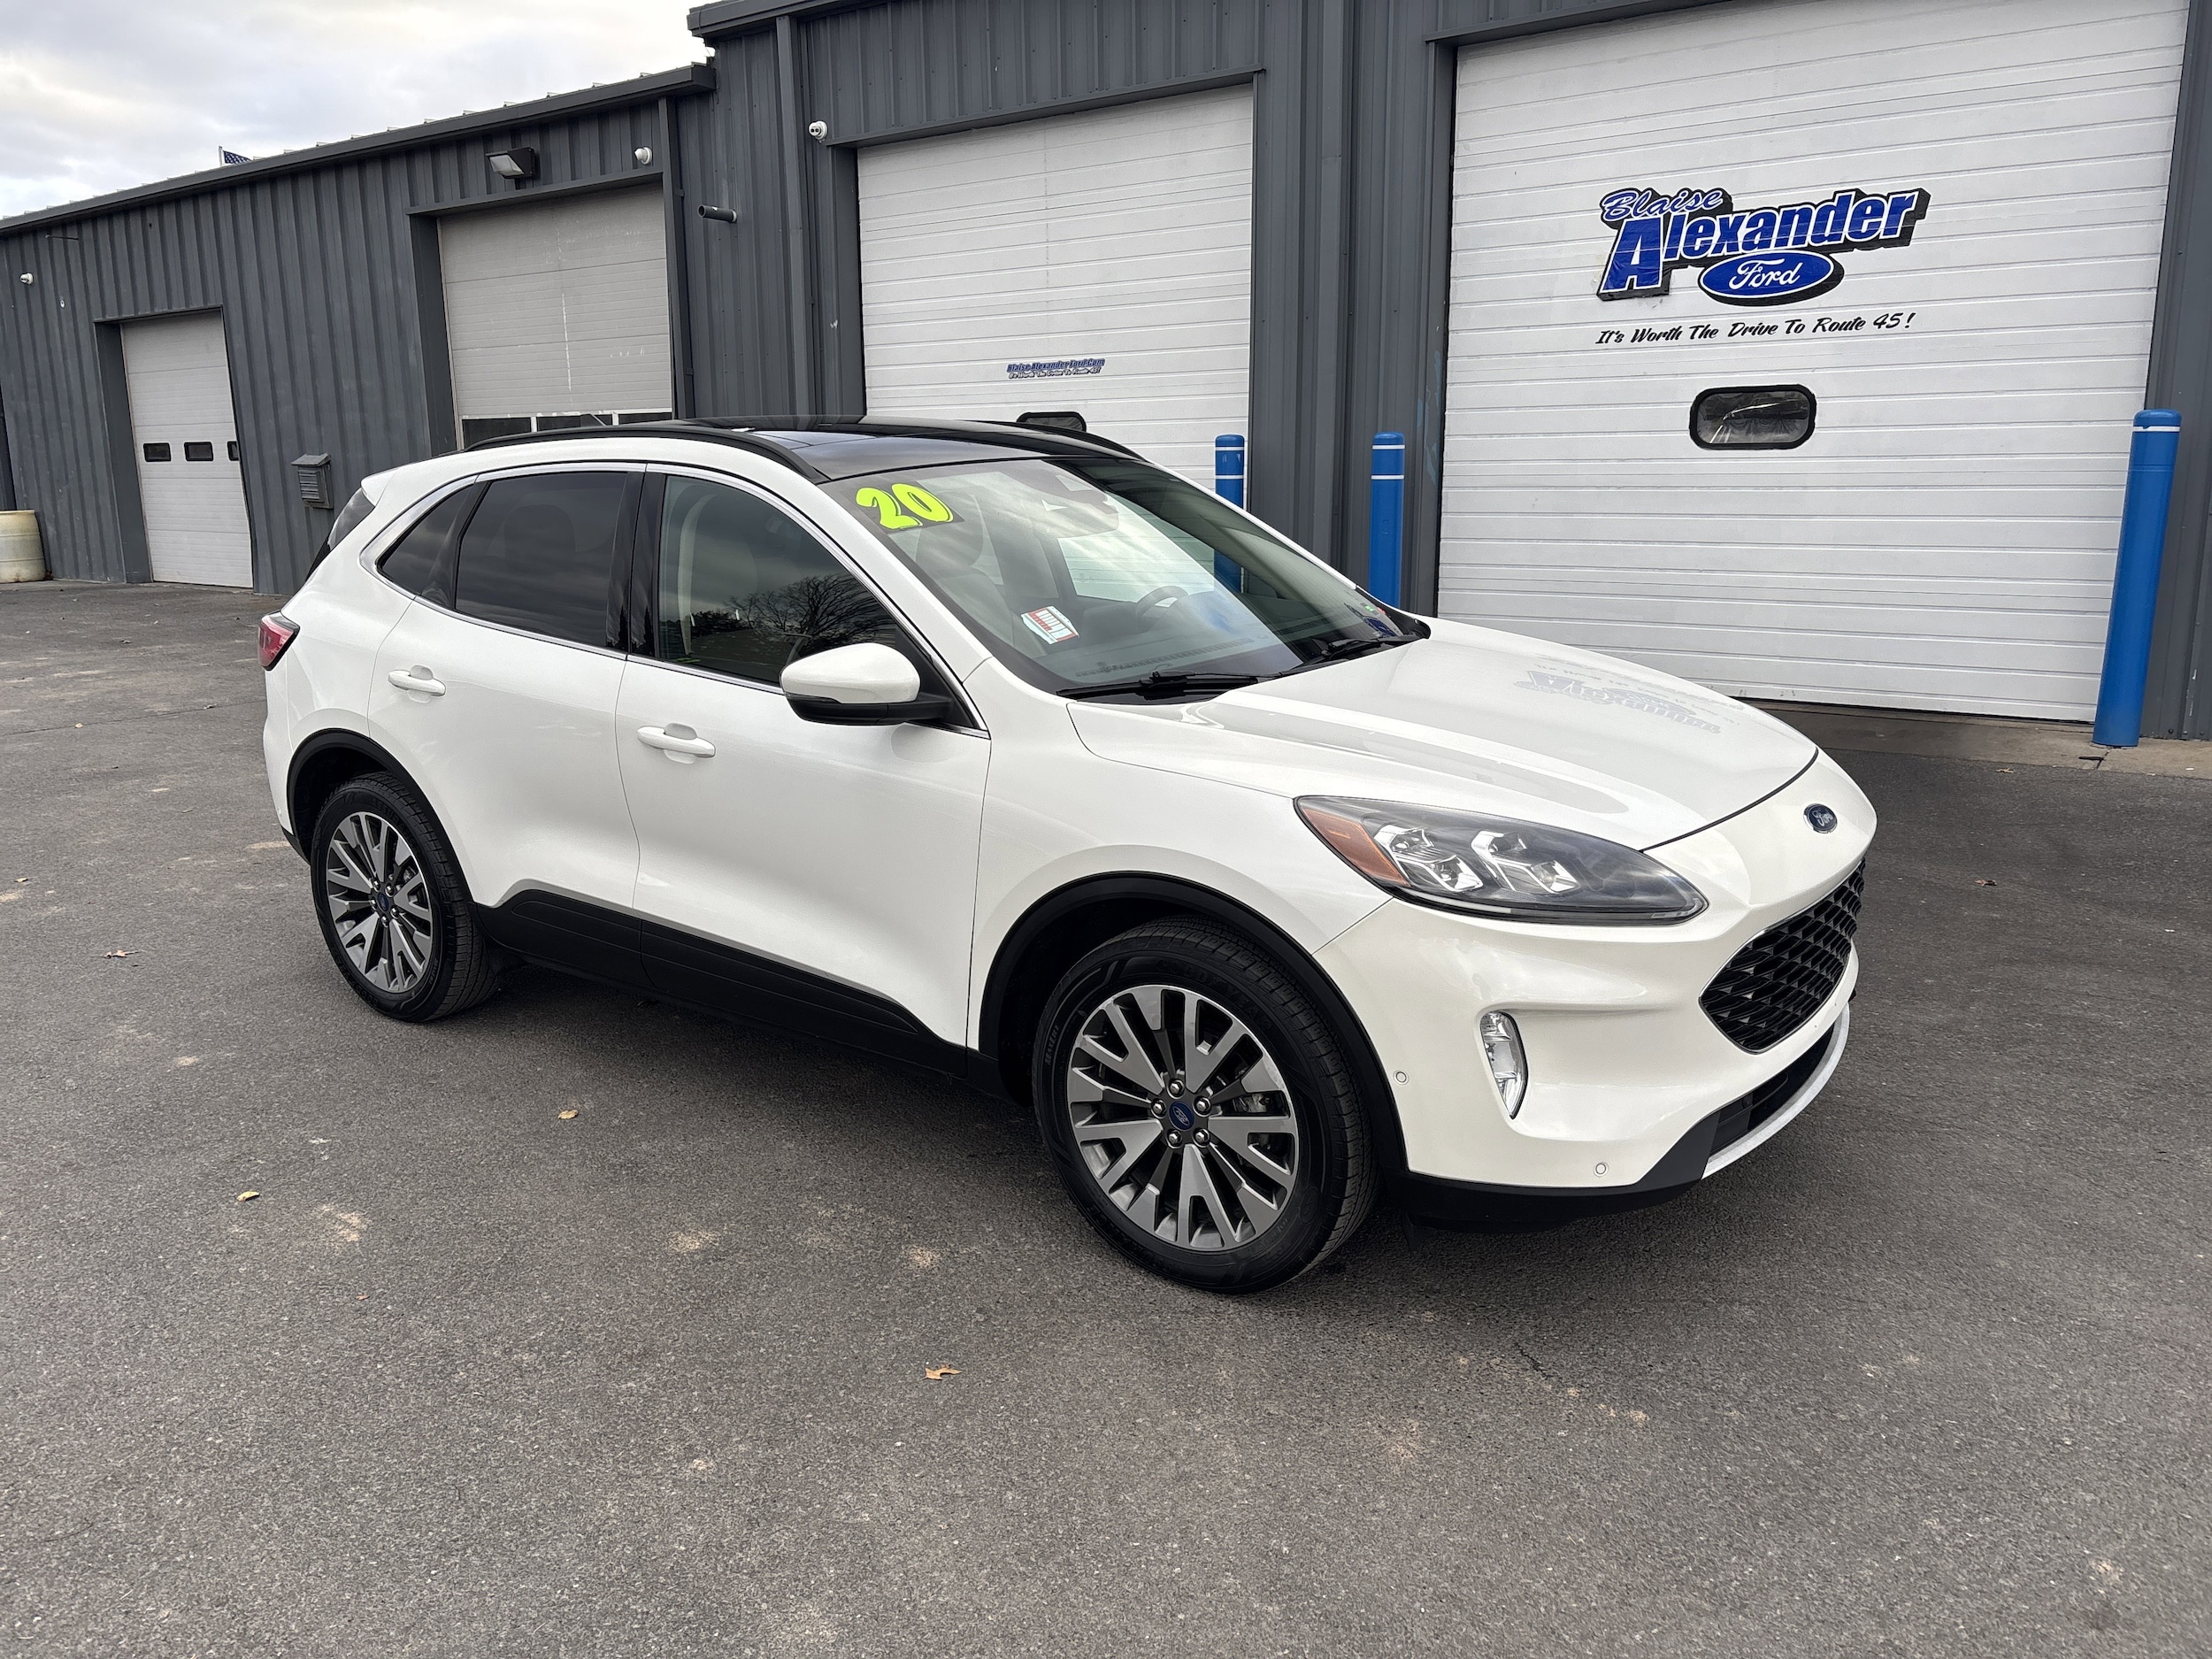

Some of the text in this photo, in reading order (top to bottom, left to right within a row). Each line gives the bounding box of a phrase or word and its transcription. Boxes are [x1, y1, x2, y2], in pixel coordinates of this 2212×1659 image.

[1601, 188, 1724, 222] Blaise
[1600, 189, 1918, 294] Alexander
[1728, 257, 1801, 291] Ford
[1594, 330, 1624, 344] It's
[1630, 326, 1684, 343] Worth
[1688, 324, 1719, 340] The
[1727, 322, 1779, 337] Drive
[1785, 319, 1806, 334] To
[1811, 316, 1867, 334] Route
[856, 483, 954, 529] 20
